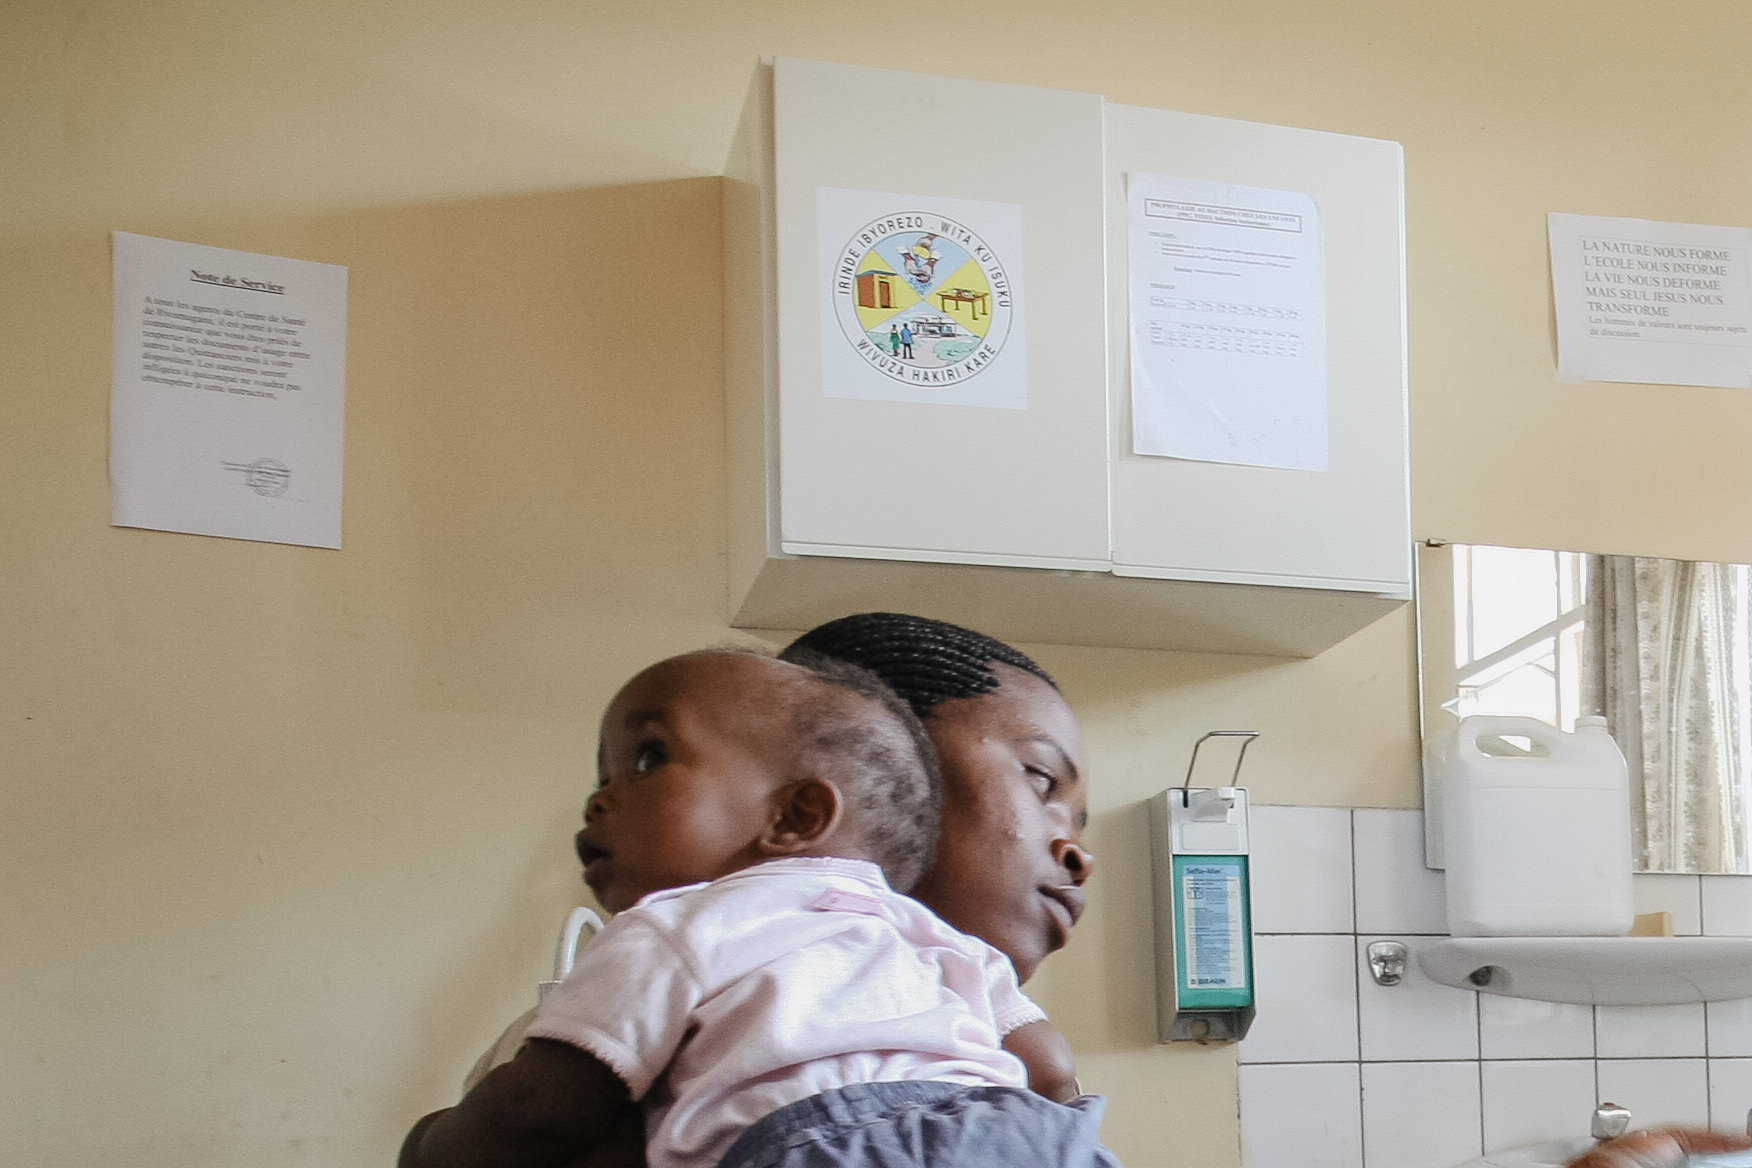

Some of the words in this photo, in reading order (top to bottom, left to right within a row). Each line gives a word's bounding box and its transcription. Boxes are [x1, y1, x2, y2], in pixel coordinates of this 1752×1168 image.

[1583, 240, 1599, 251] LA
[1602, 242, 1650, 256] NATURE
[1652, 247, 1687, 258] NOUS
[1690, 249, 1731, 261] FORME
[839, 248, 861, 295] IRINDE
[857, 217, 923, 248] IBYOREZO
[941, 222, 970, 245] WITA
[974, 246, 992, 263] KU
[988, 266, 1011, 308] ISUKU
[1637, 260, 1670, 272] NOUS
[1673, 264, 1727, 276] INFORME
[191, 269, 219, 282] Note
[222, 275, 237, 285] de
[241, 278, 285, 292] Service
[1585, 271, 1601, 282] LA
[1604, 273, 1625, 283] VIE
[1627, 275, 1660, 287] NOUS
[1663, 278, 1720, 290] DEFORME
[1586, 287, 1617, 298] MAIS
[1620, 289, 1651, 301] SEUL
[1653, 292, 1687, 304] JESUS
[1690, 294, 1724, 305] NOUS
[1587, 301, 1669, 316] TRANSFORME
[857, 338, 905, 377] WIVUZA
[912, 367, 961, 382] HAKIRI
[966, 344, 996, 374] KARE
